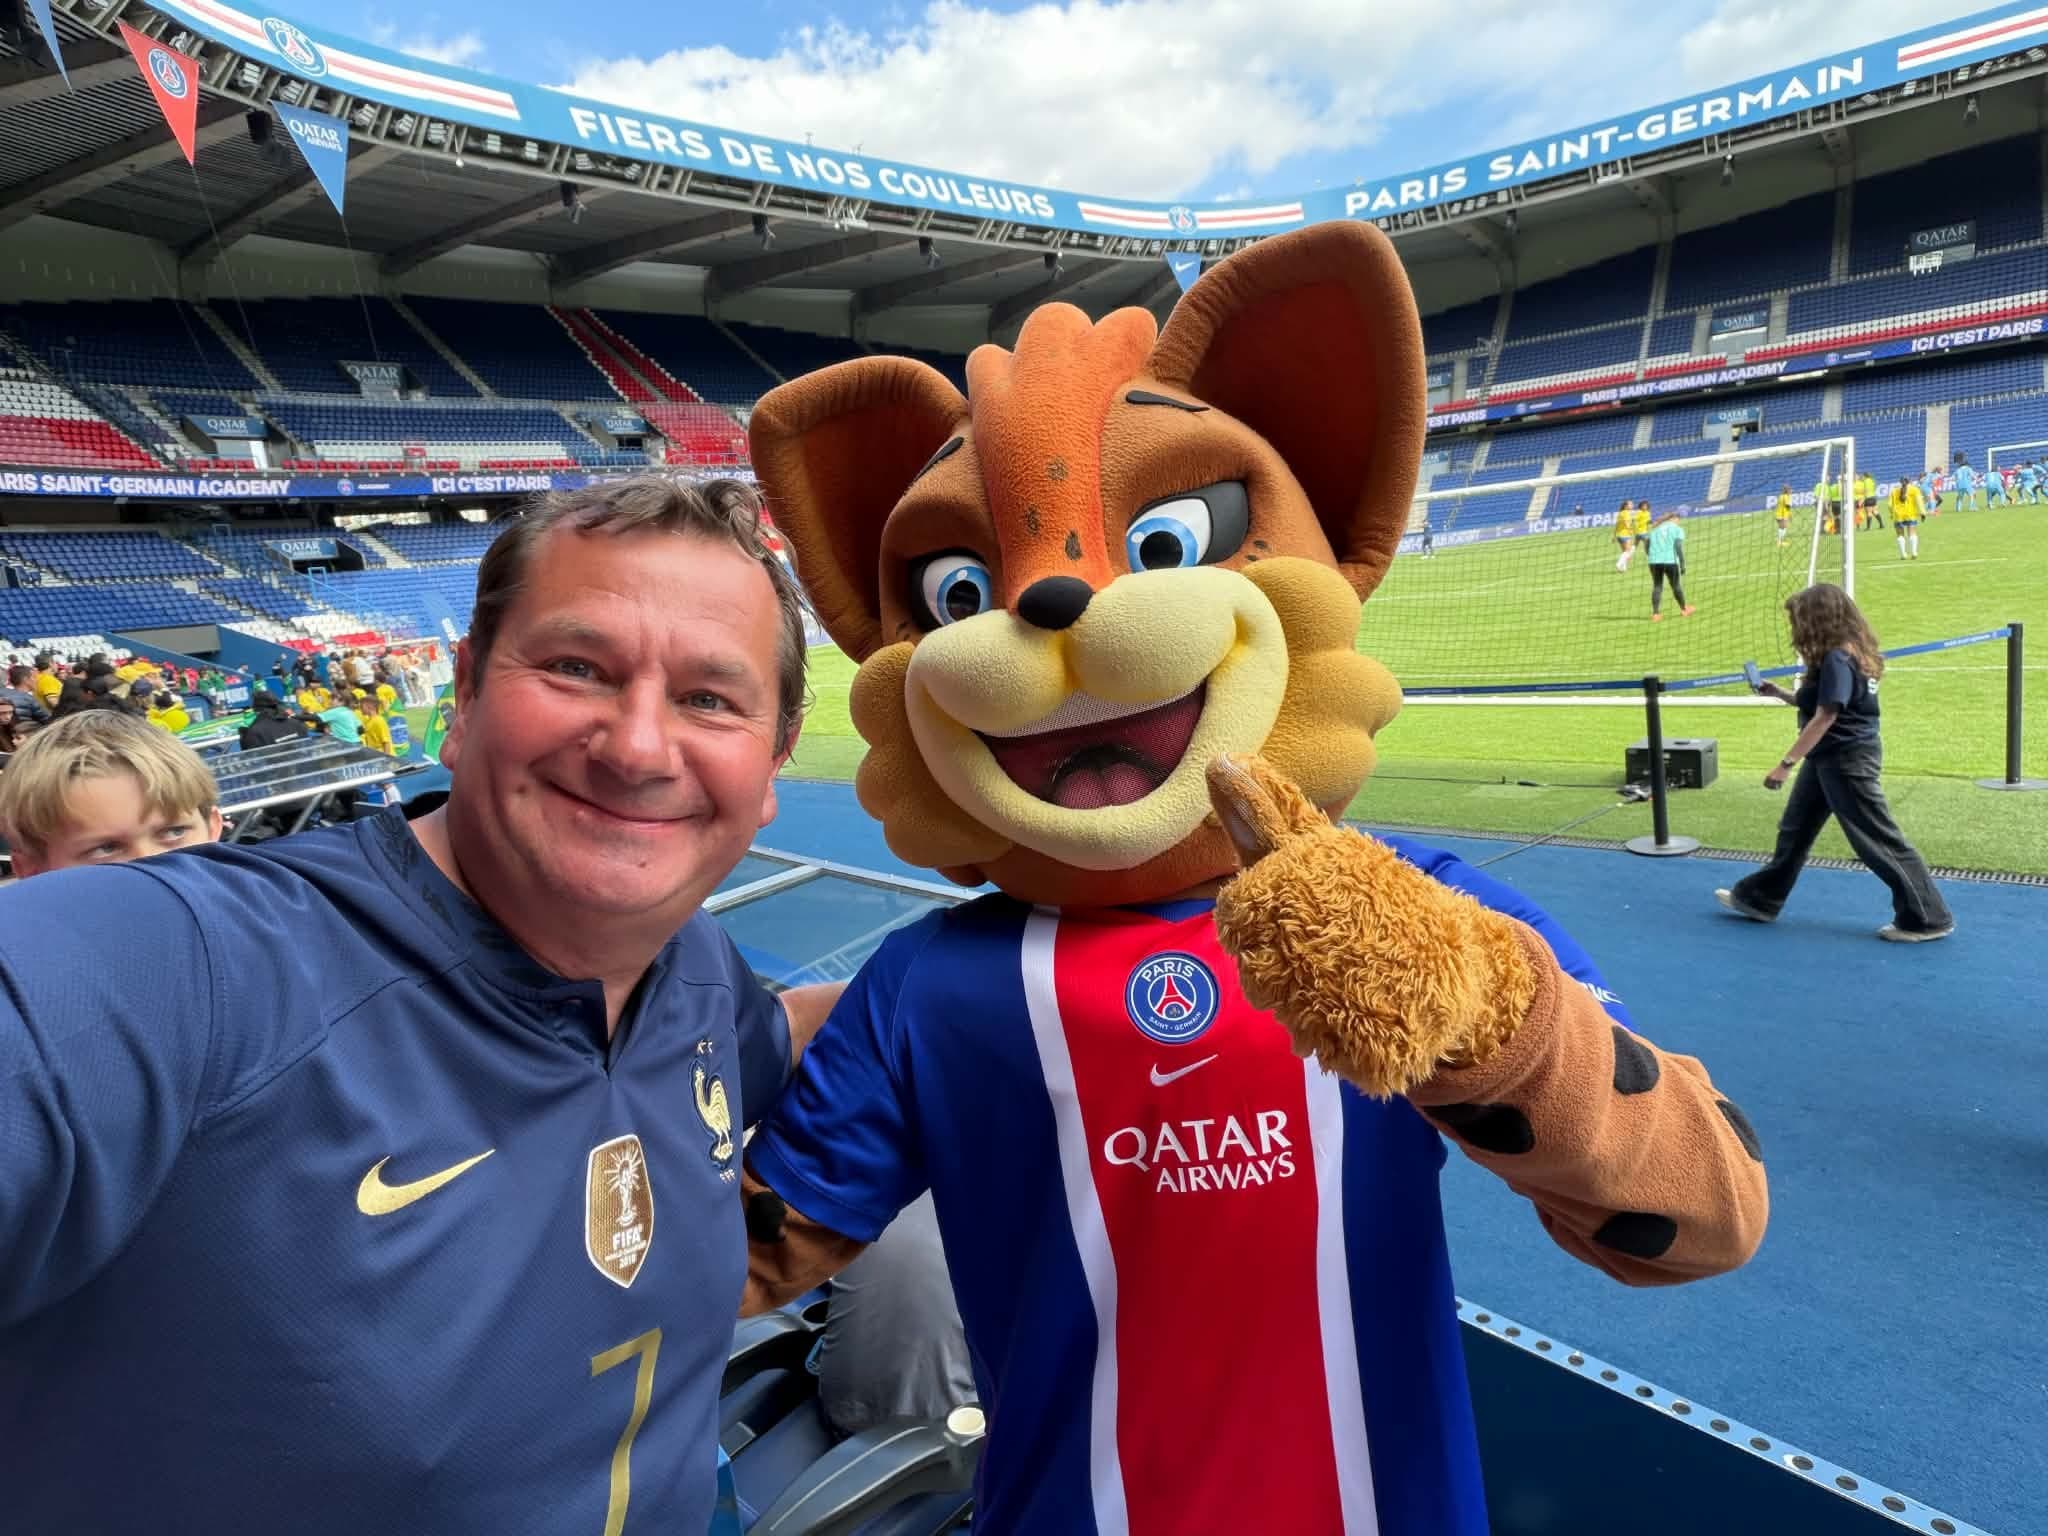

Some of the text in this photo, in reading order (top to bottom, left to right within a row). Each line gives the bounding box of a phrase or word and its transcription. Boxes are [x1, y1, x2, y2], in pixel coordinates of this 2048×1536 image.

[289, 119, 340, 144] QATAR
[1345, 57, 1864, 216] PARIS SAINT-GERMAIN
[568, 106, 1056, 219] FIERS DE NOS COULEURS
[1916, 225, 1968, 245] QATAR
[1911, 318, 2043, 352] ICI C'EST PARIS
[346, 365, 399, 381] QATAR
[1582, 361, 1788, 405] PARIS SAINT-GERMAIN ACADEMY
[207, 418, 248, 431] QATAR
[1450, 408, 1488, 425] PARIS
[41, 475, 195, 495] SAINT-GERMAIN
[198, 479, 291, 495] ACADEMY
[432, 474, 552, 493] ICI C'EST PARIS
[281, 542, 320, 554] QATAR
[1141, 961, 1195, 982] PARIS
[1104, 1110, 1293, 1173] QATAR
[1156, 1151, 1296, 1193] AIRWAYS
[612, 1225, 642, 1251] FIFA
[591, 1327, 663, 1536] 7
